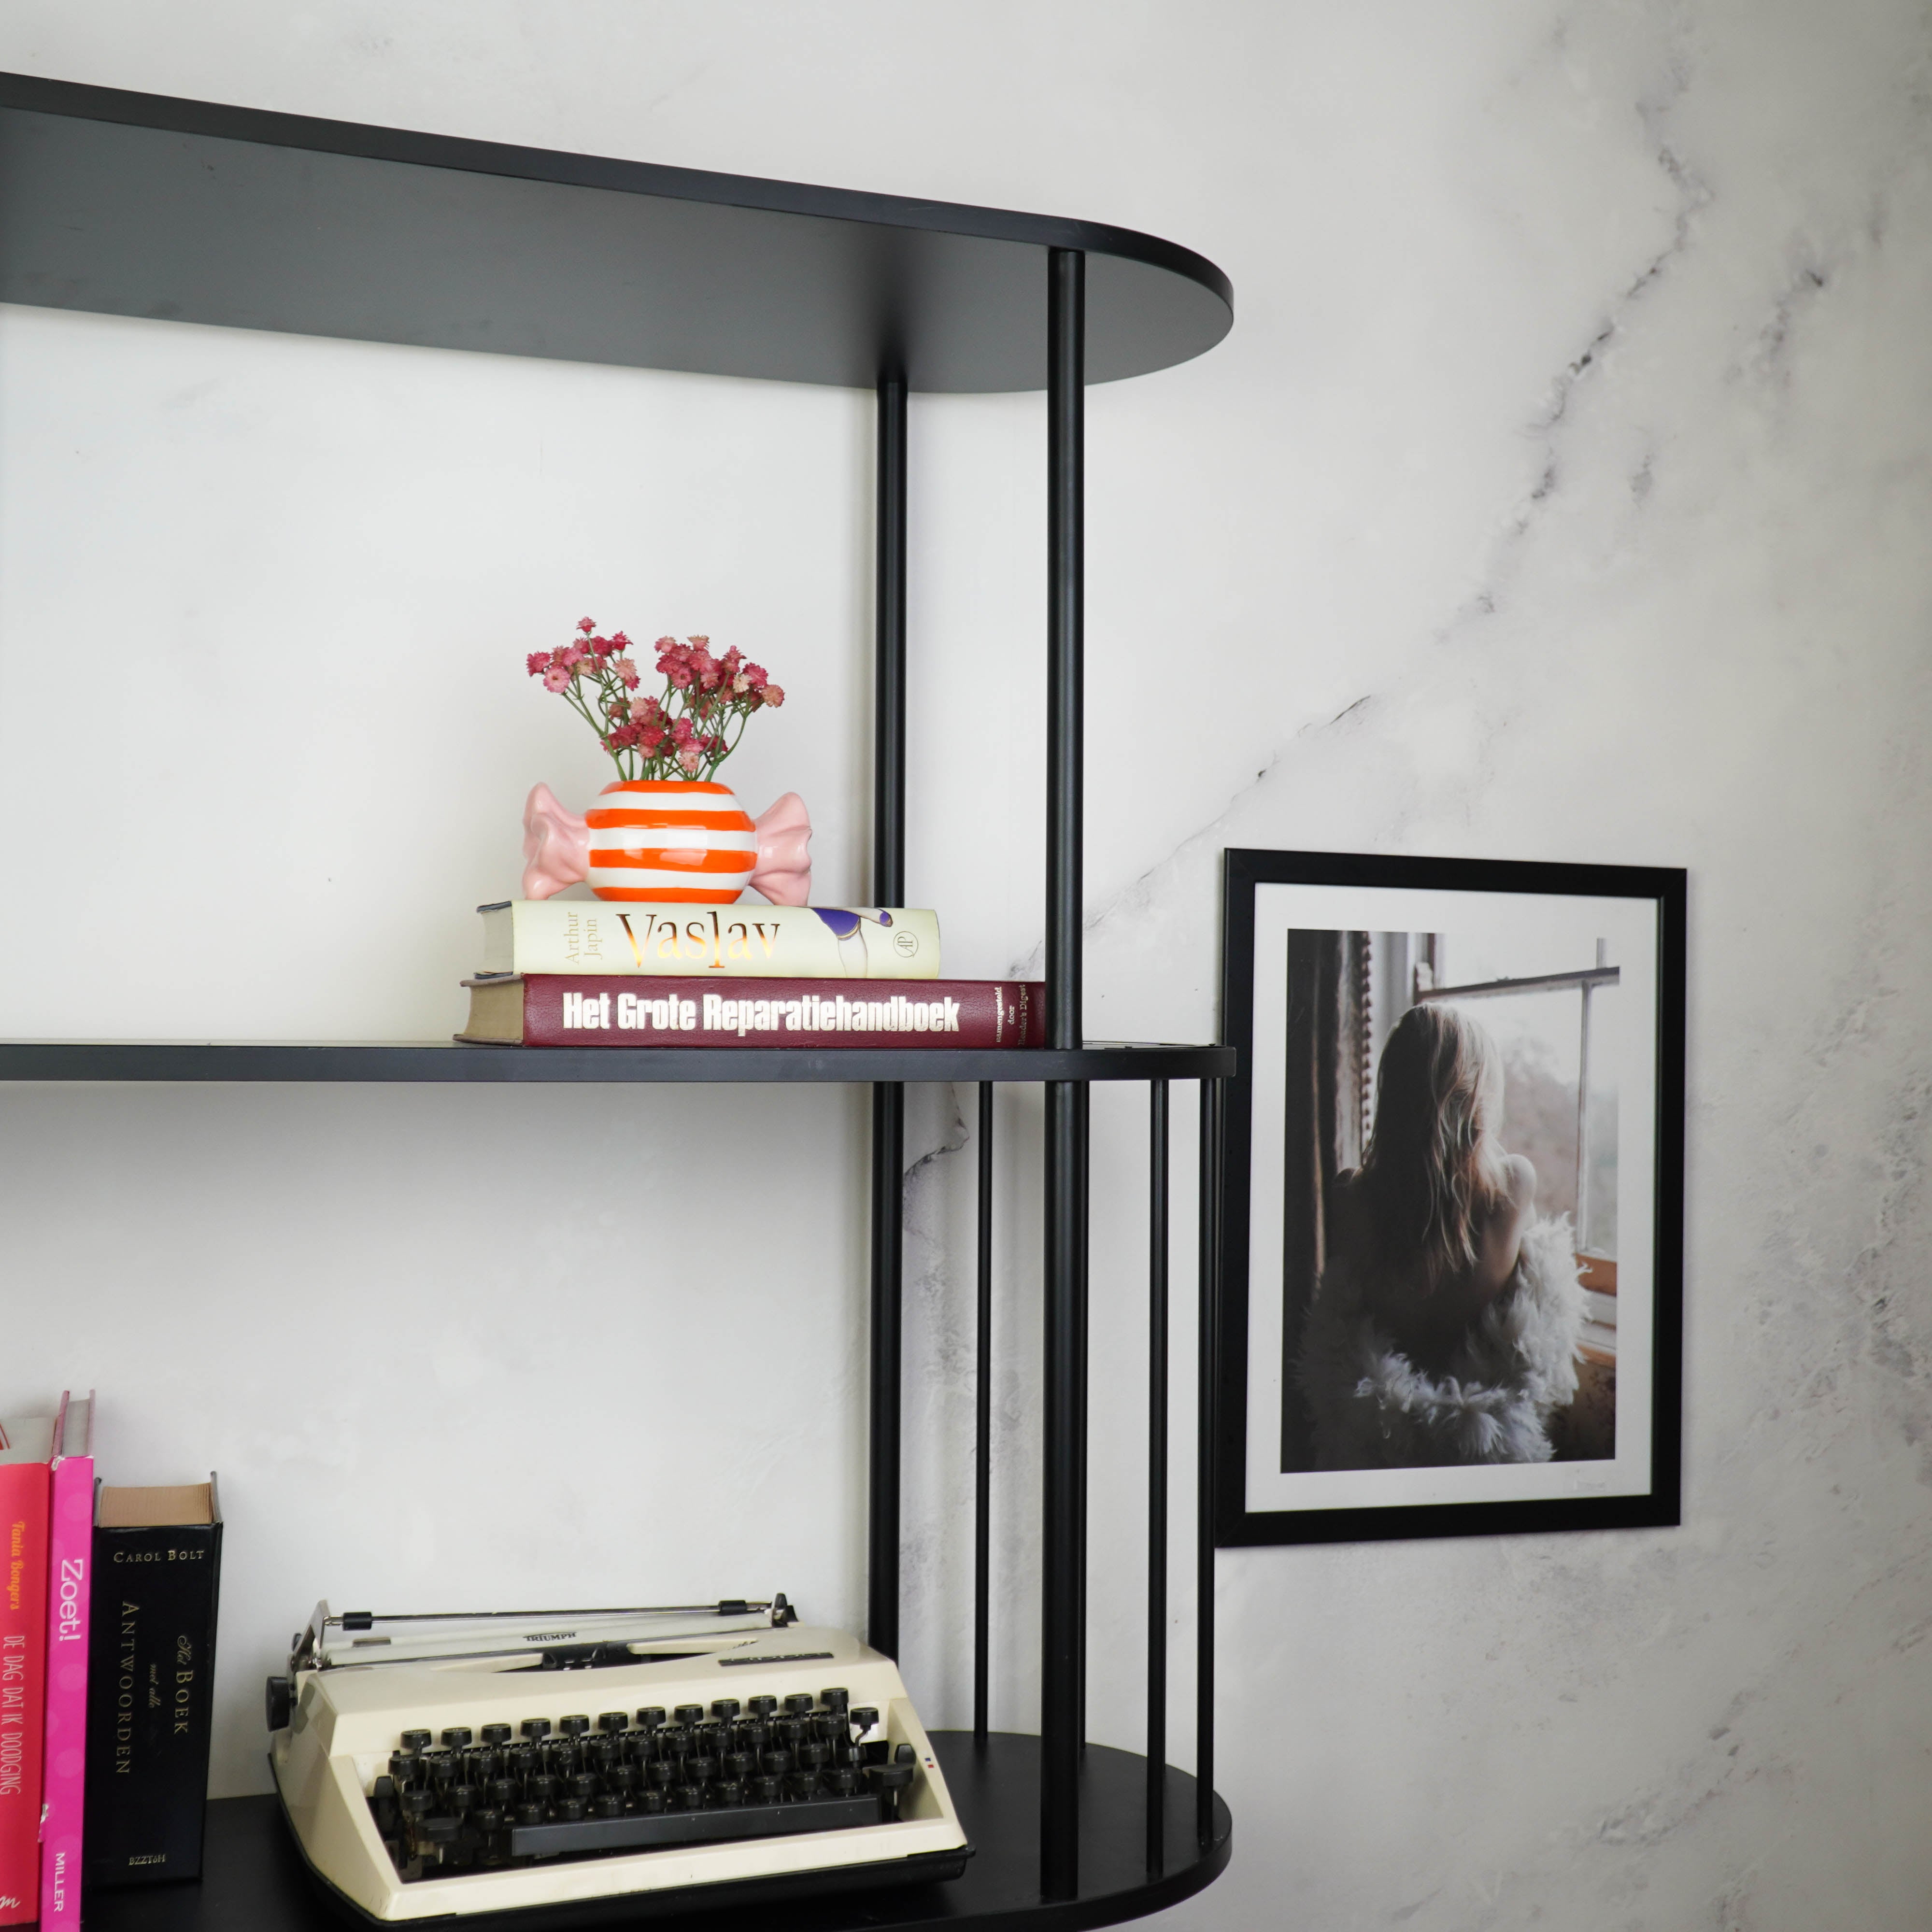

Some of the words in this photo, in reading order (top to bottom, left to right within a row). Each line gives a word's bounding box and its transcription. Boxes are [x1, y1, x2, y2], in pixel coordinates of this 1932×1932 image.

[563, 911, 580, 964] Arthur
[583, 918, 603, 960] Japin
[615, 911, 781, 968] Vaslav
[563, 992, 611, 1029] Het
[617, 993, 696, 1031] Grote
[702, 994, 960, 1037] Reparatiehandboek
[1018, 984, 1028, 1010] Digest
[11, 1521, 25, 1557] Tania
[114, 1552, 161, 1563] CAROL
[168, 1549, 204, 1561] BOLT
[7, 1560, 24, 1610] Bongers
[58, 1558, 84, 1641] Zoet!
[3, 1635, 25, 1649] DE
[177, 1635, 192, 1665] Het
[523, 1632, 577, 1642] TRIUMPH
[2, 1655, 25, 1681] DAG
[149, 1663, 158, 1685] met
[1, 1687, 24, 1708] DAT
[115, 1601, 140, 1773] ANTWOORDEN
[148, 1687, 161, 1708] alle
[174, 1670, 194, 1734] BOEK
[1, 1714, 23, 1725] IK
[0, 1732, 23, 1795] DOODGING
[54, 1852, 66, 1912] MILLER
